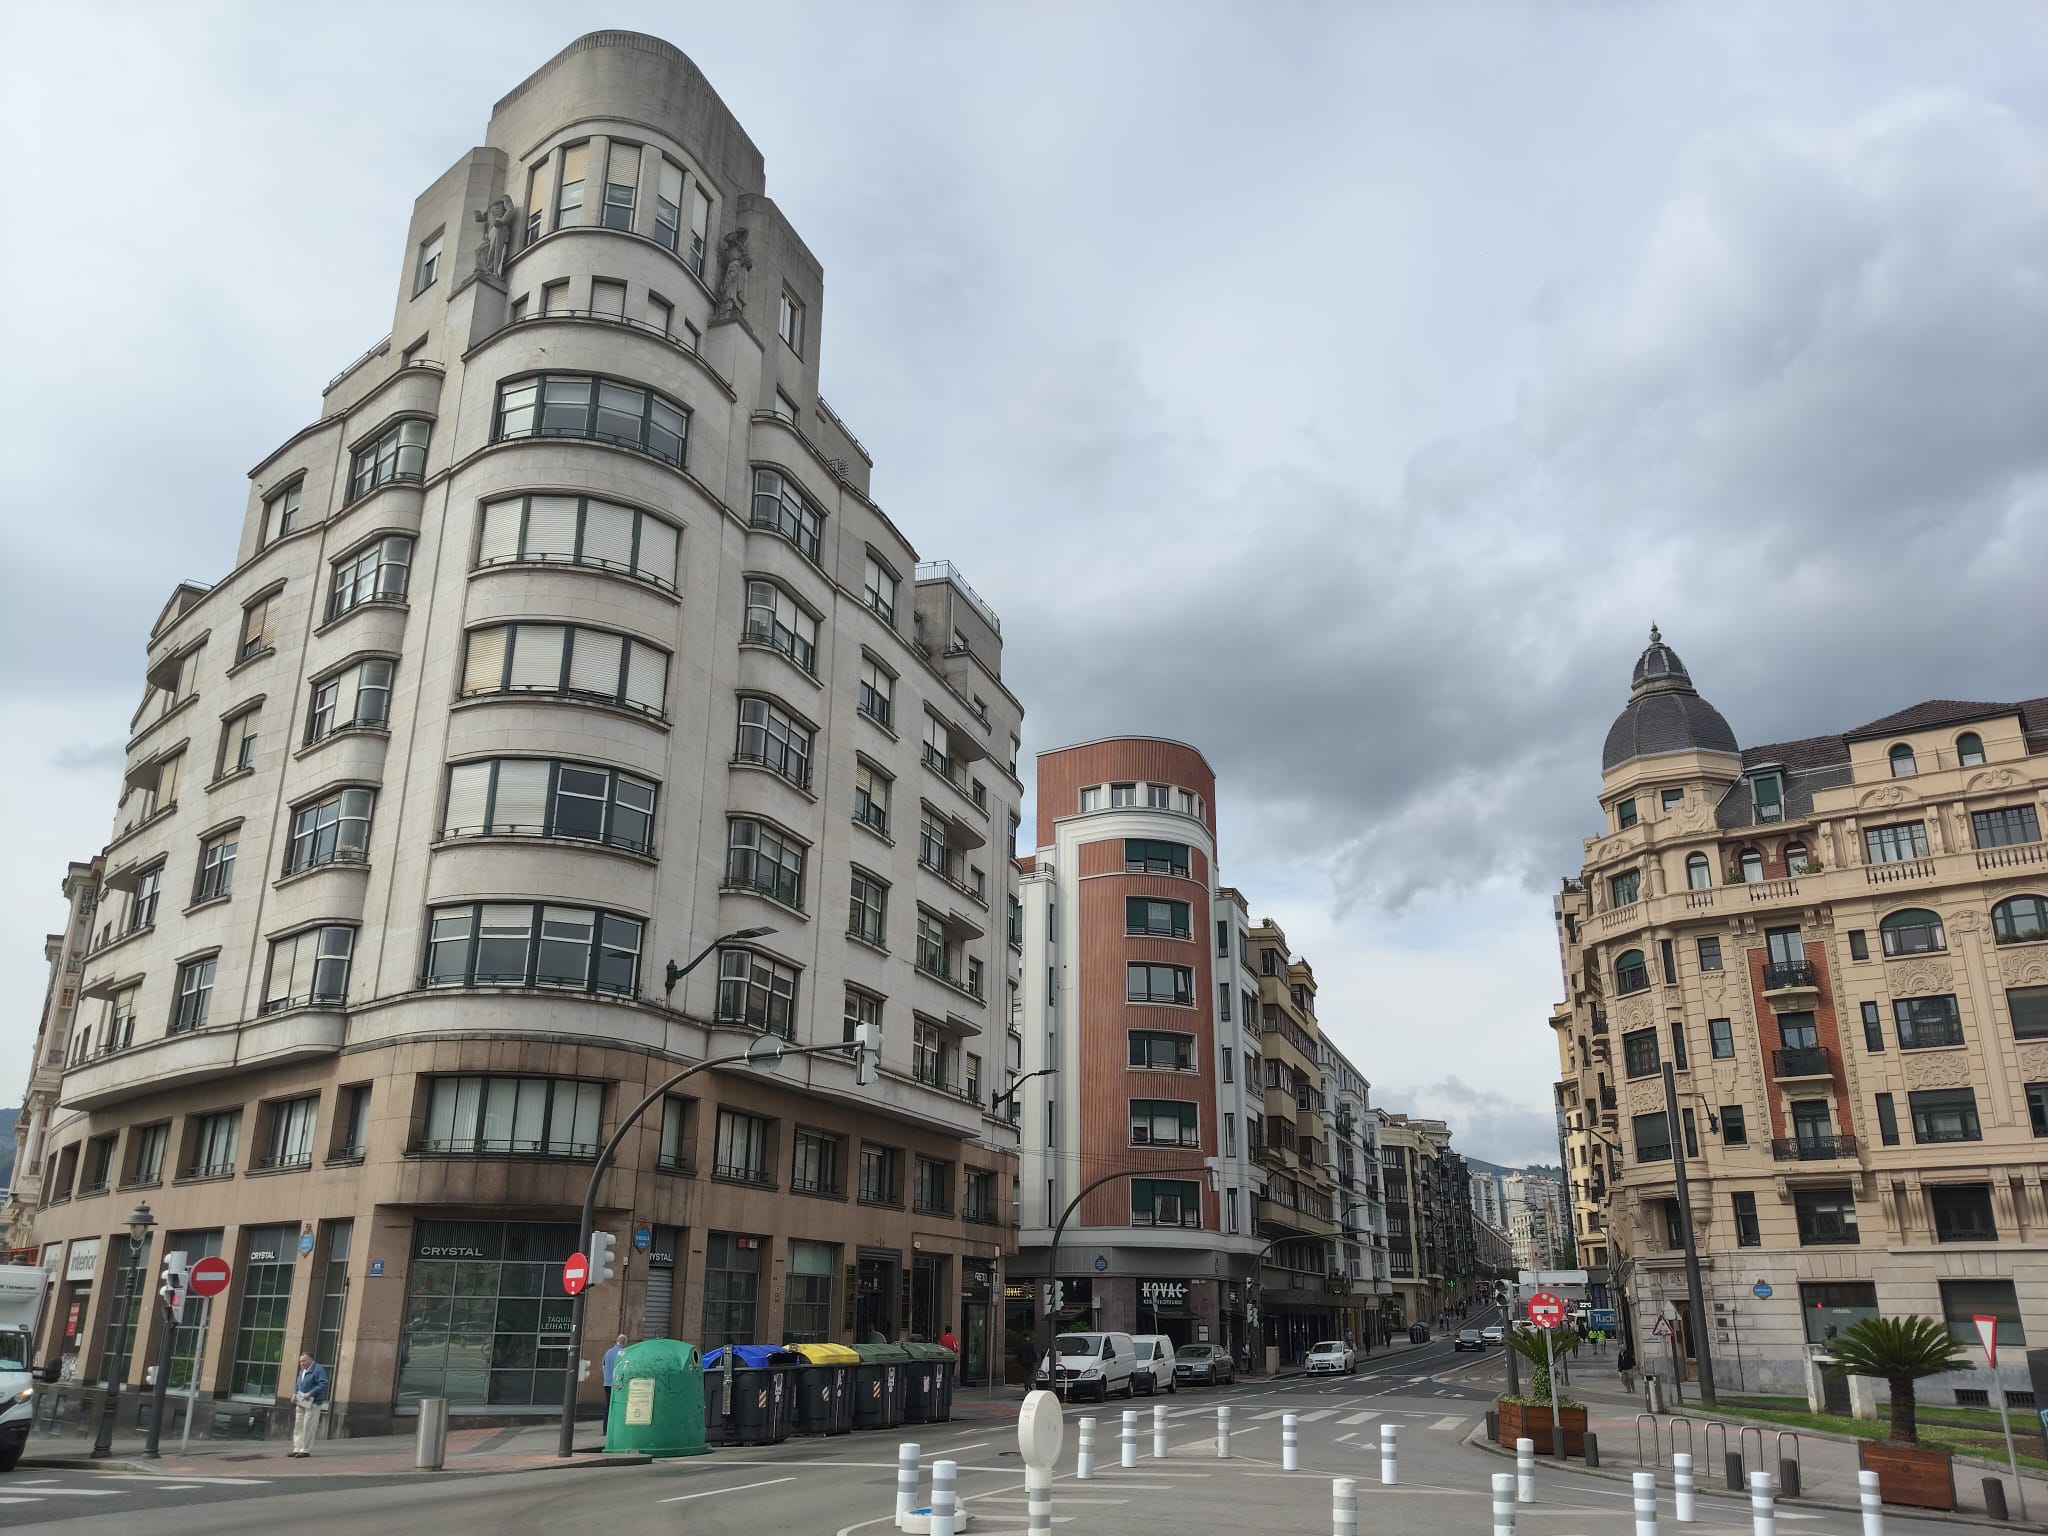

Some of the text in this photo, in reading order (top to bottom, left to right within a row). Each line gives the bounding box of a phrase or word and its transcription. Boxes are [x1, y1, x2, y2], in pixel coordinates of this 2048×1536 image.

[250, 1251, 275, 1260] CRYSTAL
[421, 1246, 483, 1256] CRYSTAL
[71, 1250, 97, 1271] interior
[1143, 1282, 1183, 1298] KOVAC
